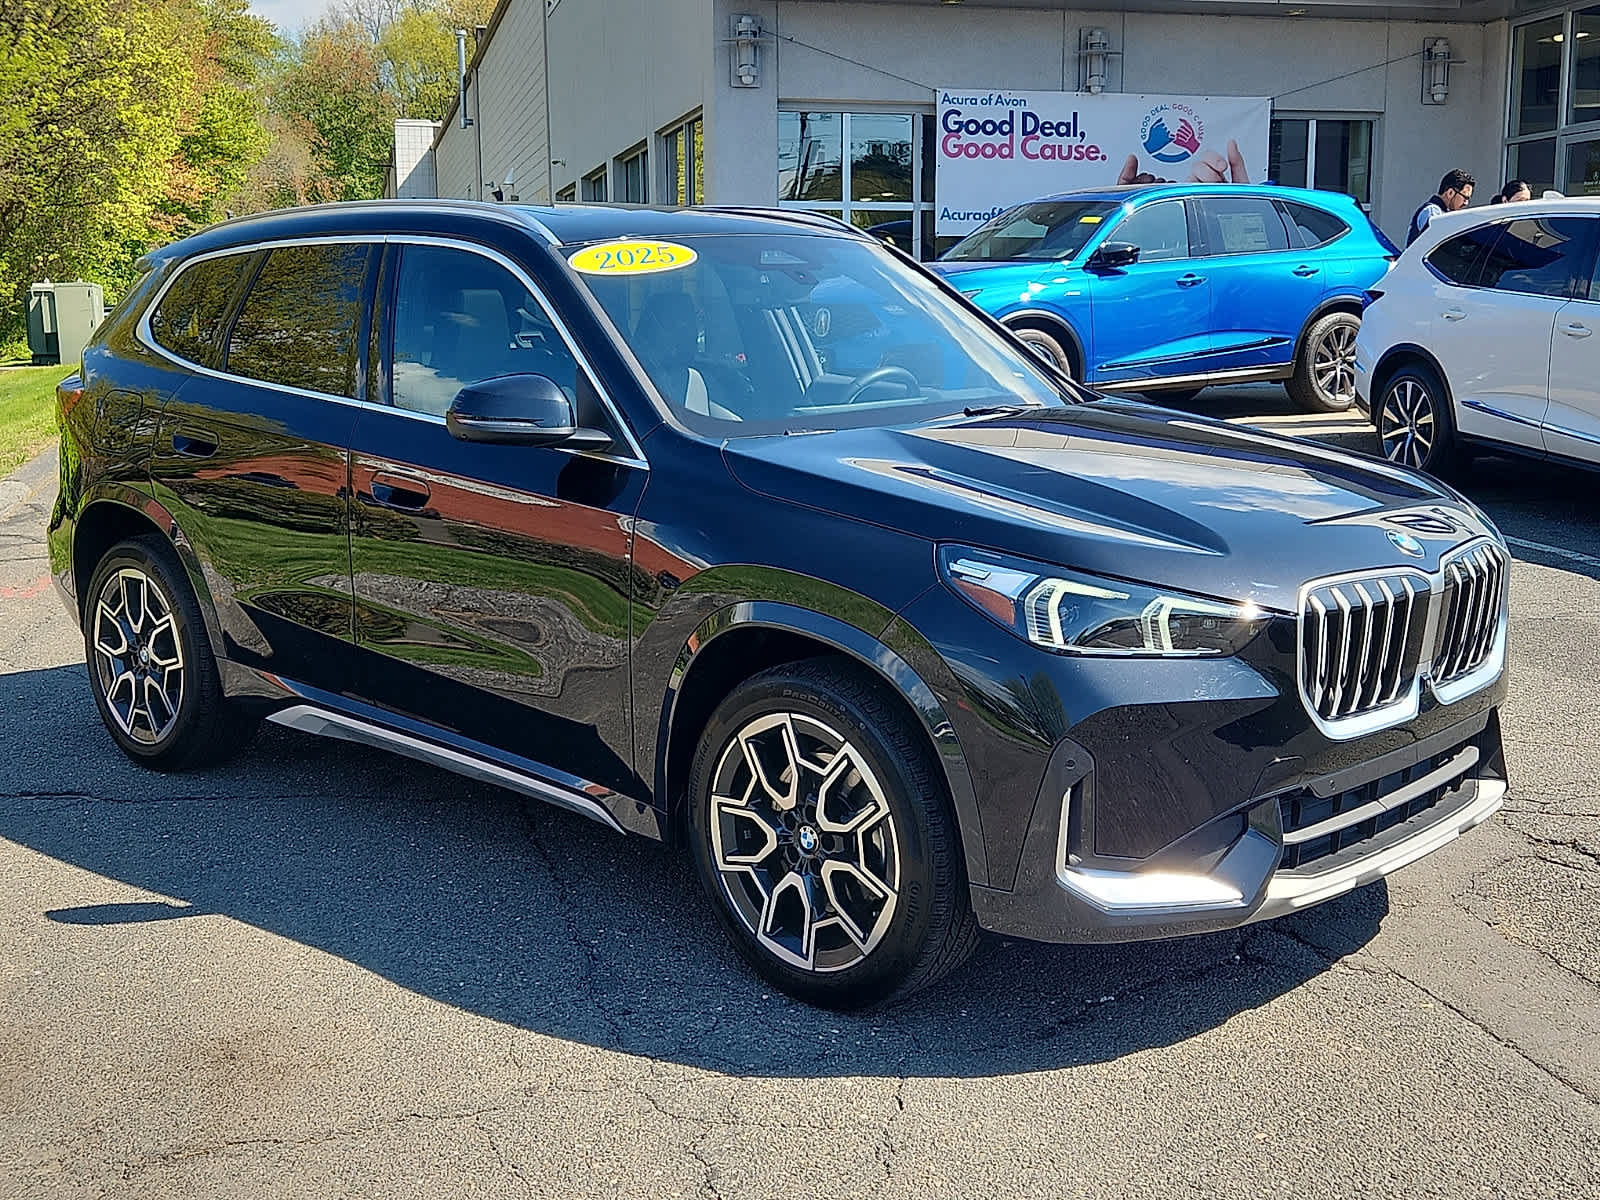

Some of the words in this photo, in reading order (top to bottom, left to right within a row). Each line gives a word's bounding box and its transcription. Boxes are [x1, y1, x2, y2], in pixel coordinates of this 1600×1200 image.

[941, 93, 978, 105] Acura
[980, 93, 993, 106] of
[994, 94, 1027, 107] Avon
[942, 109, 1015, 136] Good
[1021, 111, 1086, 143] Deal,
[1141, 115, 1151, 140] GOOD
[1172, 103, 1193, 116] GOOD
[941, 132, 1015, 159] Good
[1020, 134, 1107, 161] Cause.
[595, 245, 676, 269] 2025
